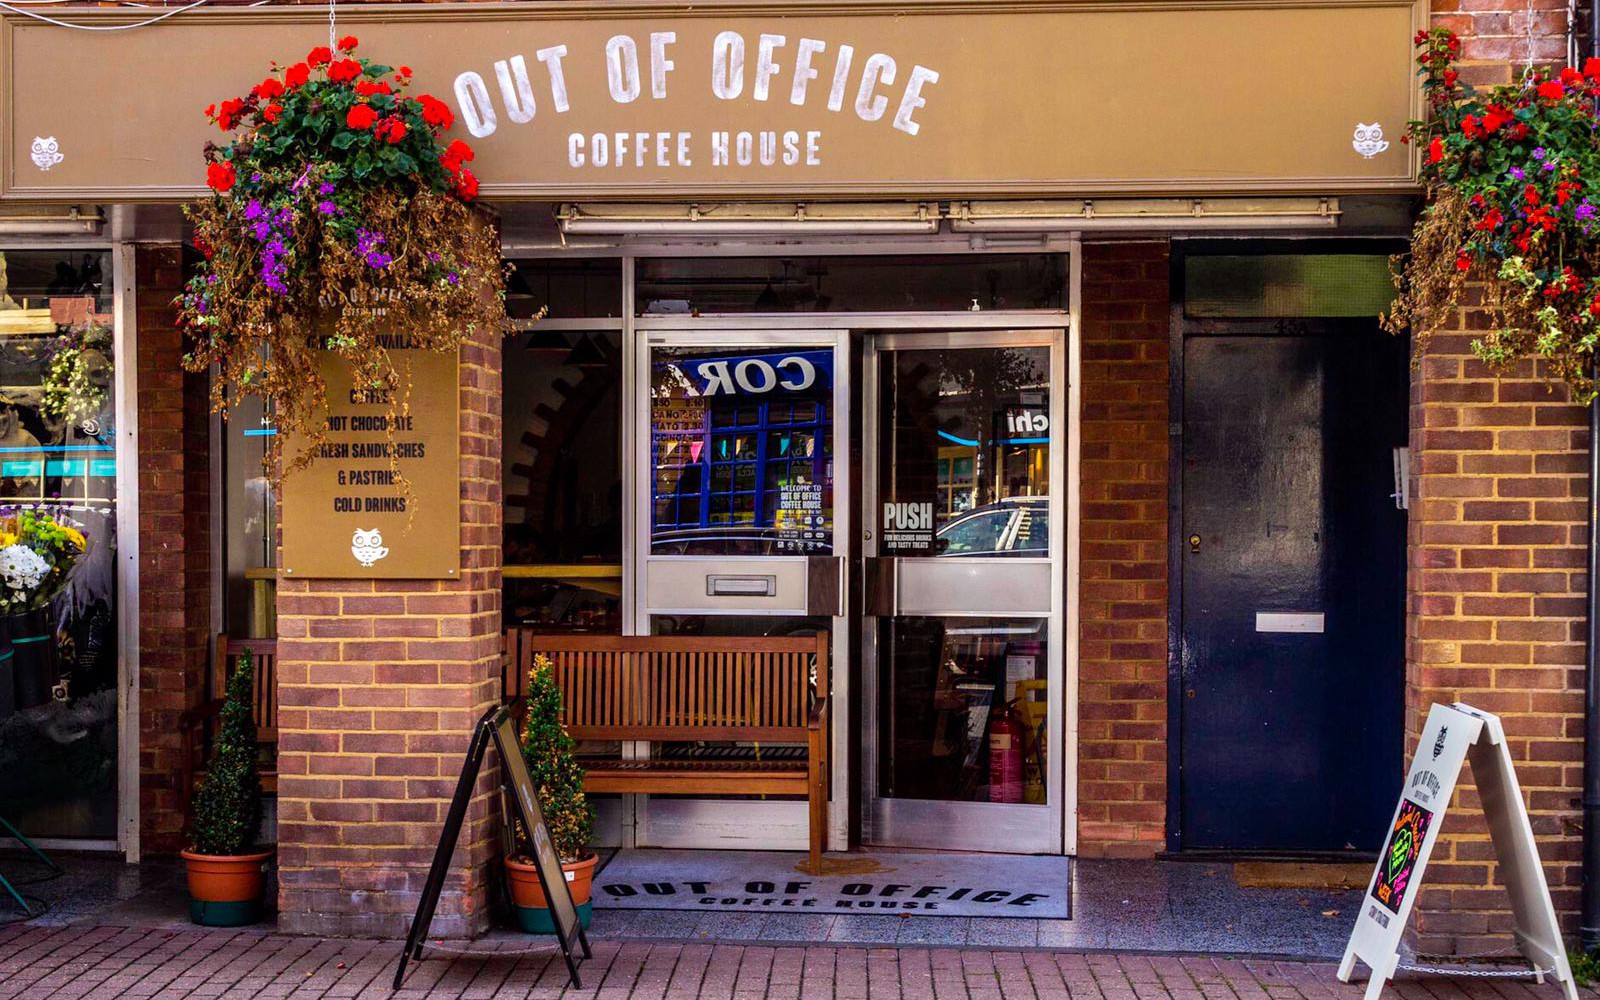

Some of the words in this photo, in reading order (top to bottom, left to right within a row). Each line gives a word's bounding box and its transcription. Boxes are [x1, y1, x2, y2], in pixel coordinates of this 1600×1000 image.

[453, 44, 570, 138] OUT
[606, 31, 677, 103] OF
[711, 30, 939, 136] OFFICE
[568, 132, 692, 168] COFFEE
[712, 130, 821, 167] HOUSE
[351, 416, 413, 431] CHOCOATE
[338, 470, 346, 485] &
[780, 492, 793, 501] OUT
[793, 492, 801, 501] OF
[801, 492, 822, 501] OFFICE
[334, 497, 362, 512] COLD
[365, 497, 406, 512] DRINKS
[780, 501, 801, 509] COFFEE
[802, 501, 822, 509] HOUSE
[884, 502, 933, 529] PUSH
[601, 881, 711, 896] OUT
[745, 881, 812, 894] OF
[840, 883, 1050, 906] OFFICE
[698, 897, 818, 907] COFFEE
[835, 900, 939, 910] HOUSE
